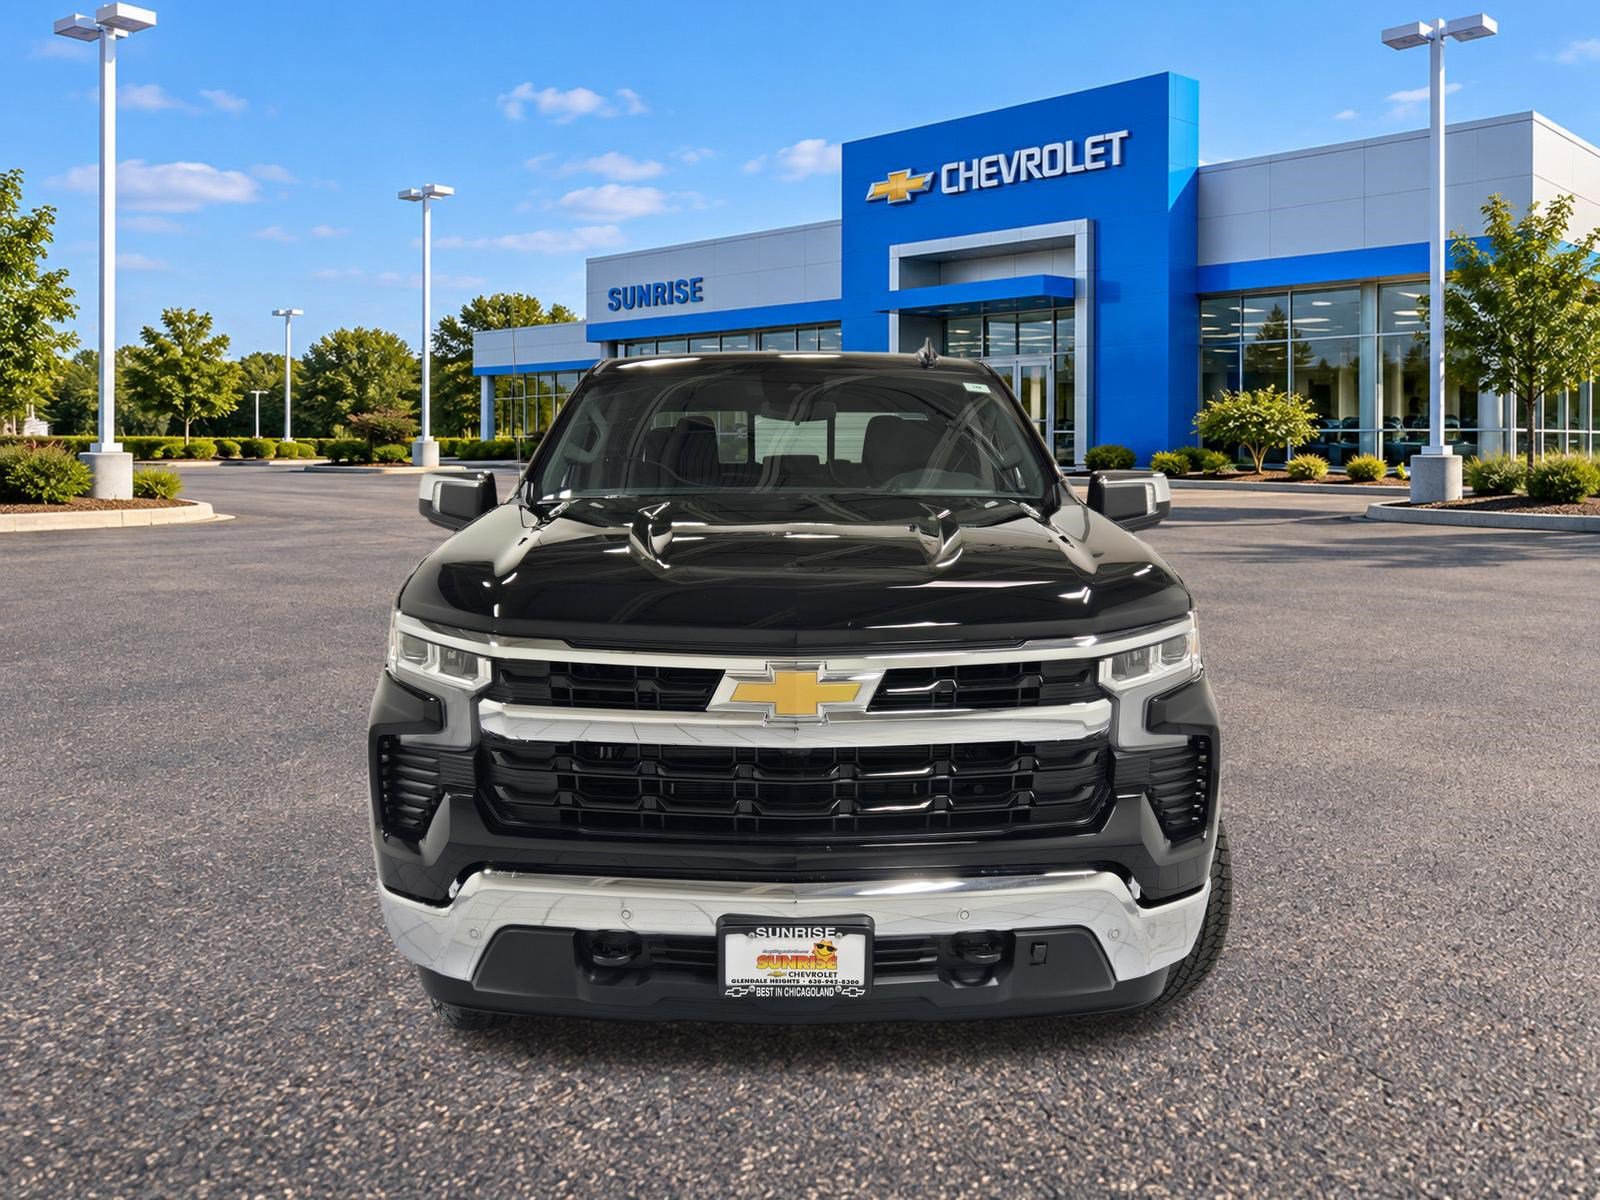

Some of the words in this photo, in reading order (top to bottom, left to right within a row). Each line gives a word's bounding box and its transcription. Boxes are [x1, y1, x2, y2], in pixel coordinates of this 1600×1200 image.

[941, 130, 1129, 194] CHEVROLET
[607, 277, 704, 312] SUNRISE
[755, 927, 837, 939] SUNRISE
[756, 954, 838, 970] SUNRISE
[756, 987, 774, 997] BEST
[775, 987, 783, 997] IN
[784, 987, 835, 997] CHICAGOLAND
